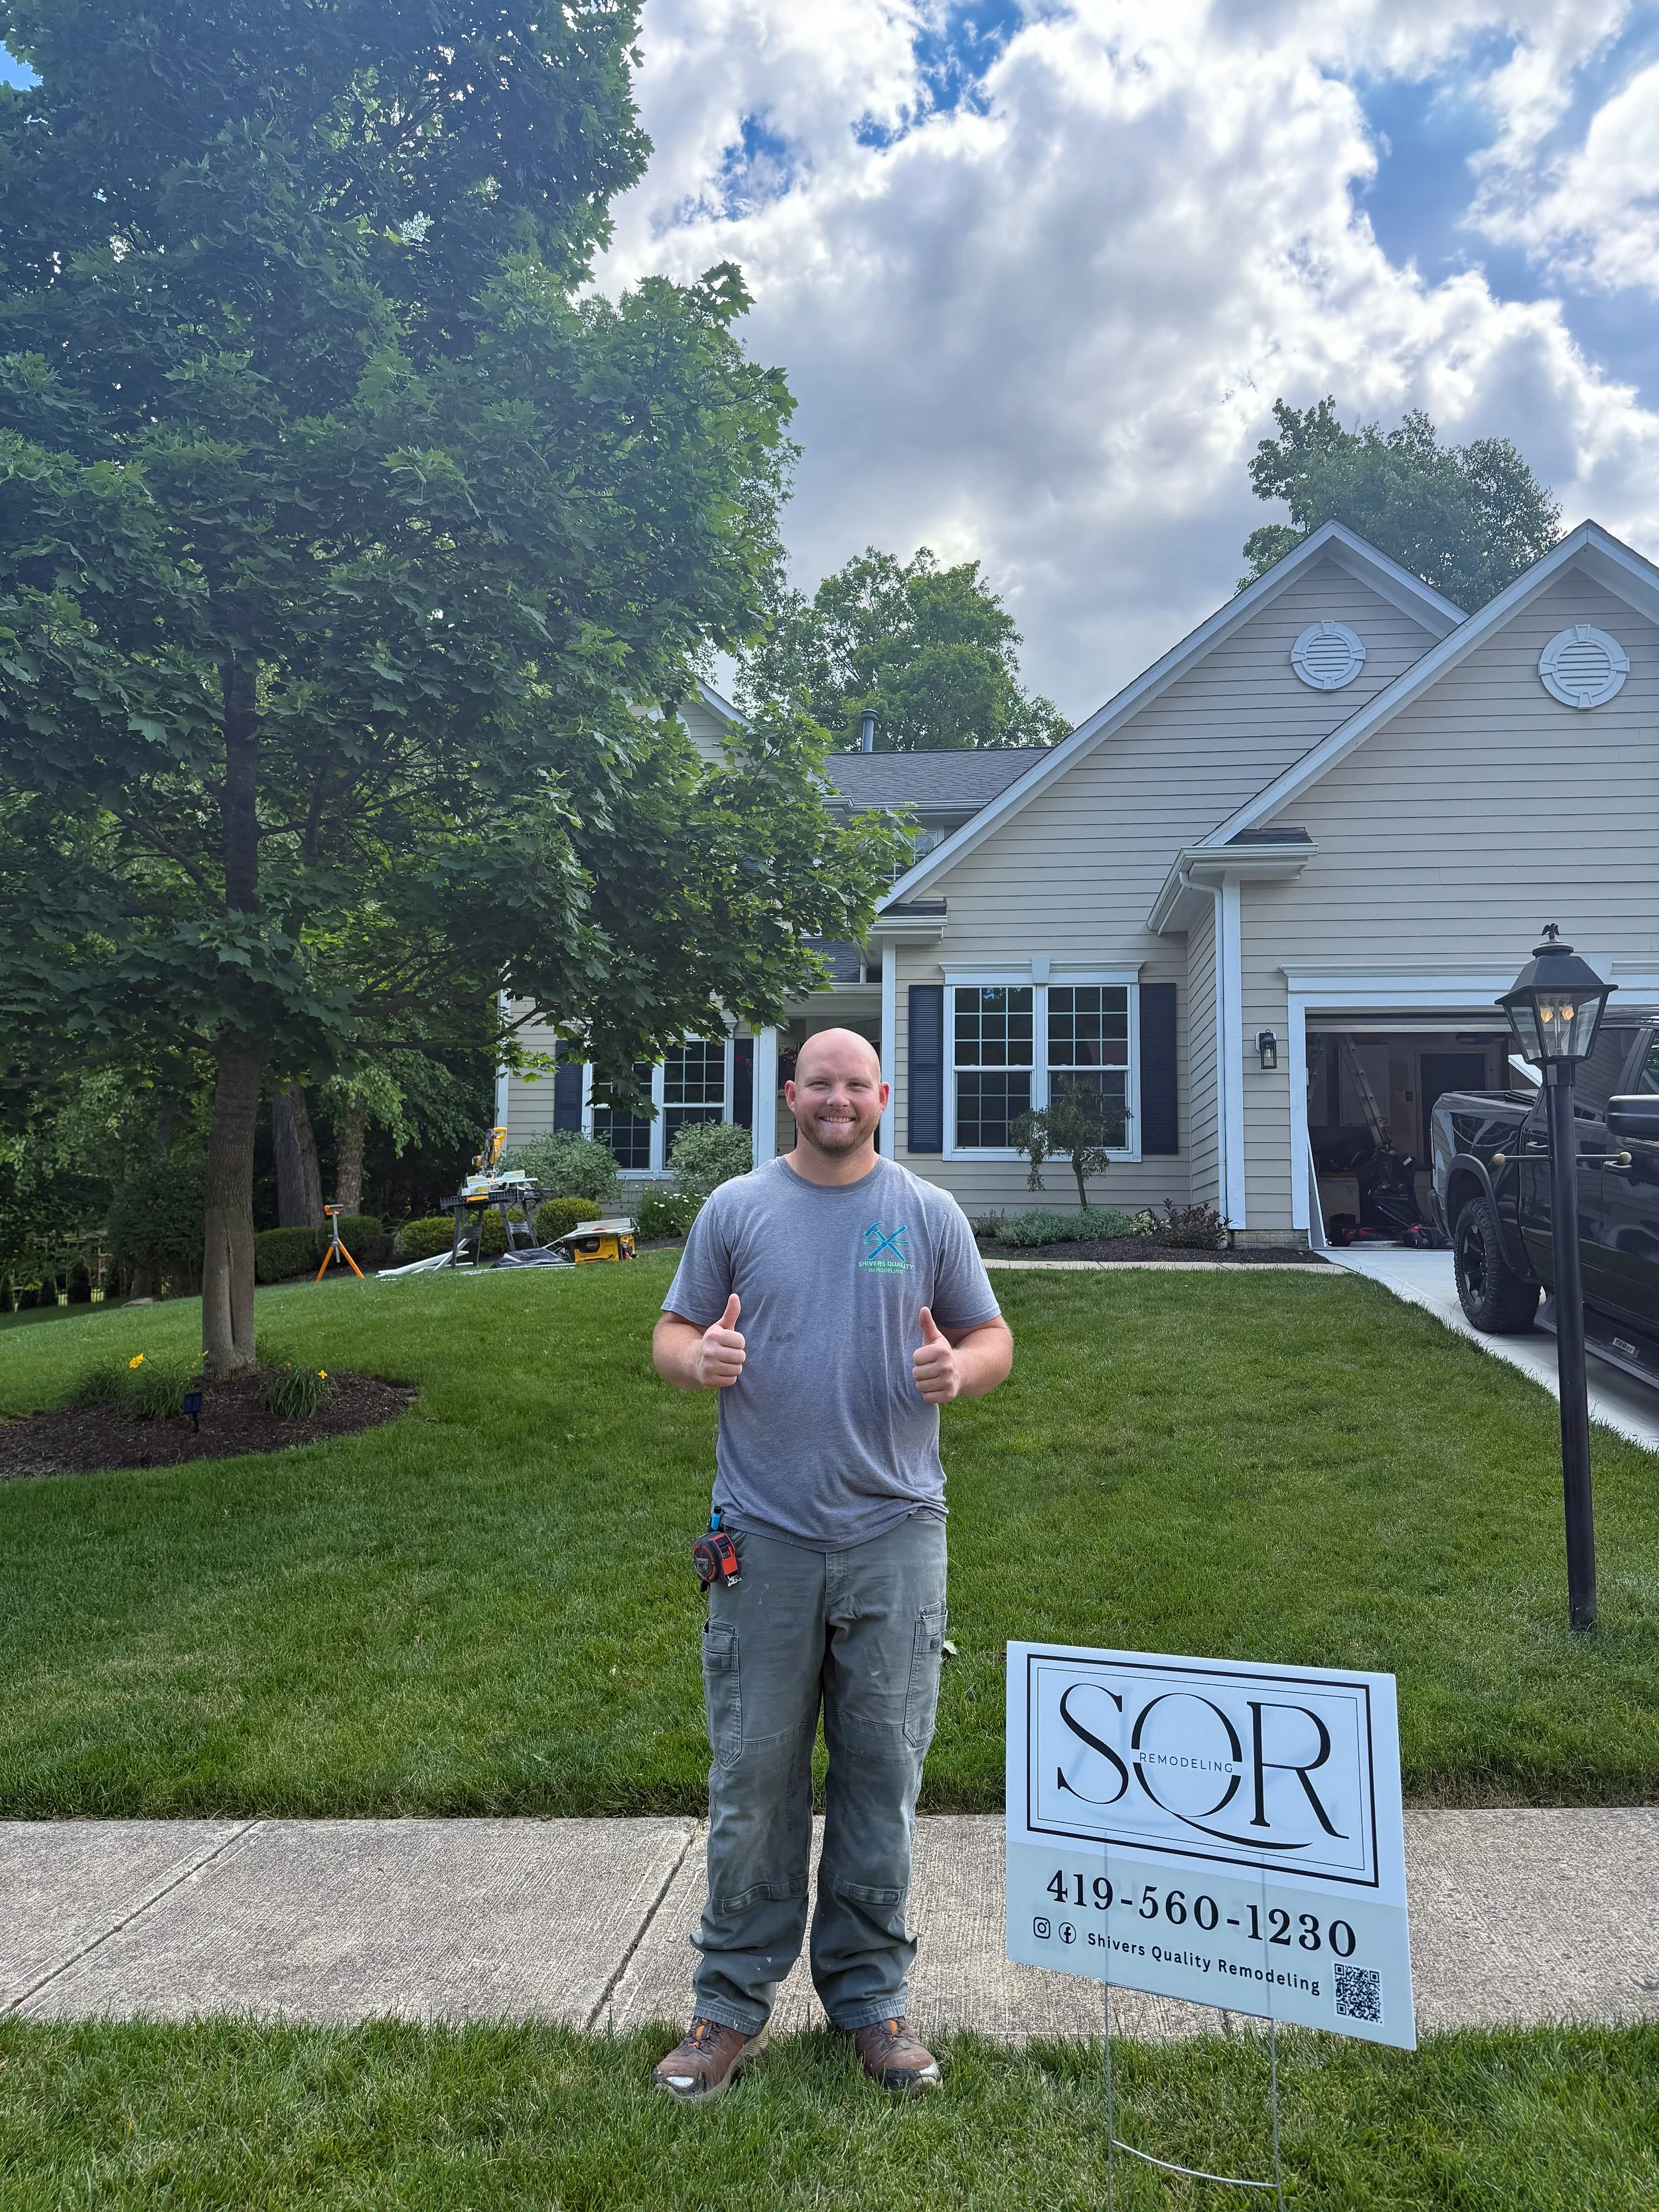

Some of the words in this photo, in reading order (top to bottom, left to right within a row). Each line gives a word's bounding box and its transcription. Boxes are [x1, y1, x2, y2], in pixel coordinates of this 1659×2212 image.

[887, 1261, 914, 1270] QUALITY
[1057, 1683, 1349, 1850] SQR
[1139, 1752, 1233, 1773] REMODELING
[1046, 1869, 1356, 1958] 419-560-1230
[1088, 1932, 1146, 1956] Shivers
[1151, 1945, 1211, 1973] Quality
[1218, 1958, 1321, 1996] Remodeling
